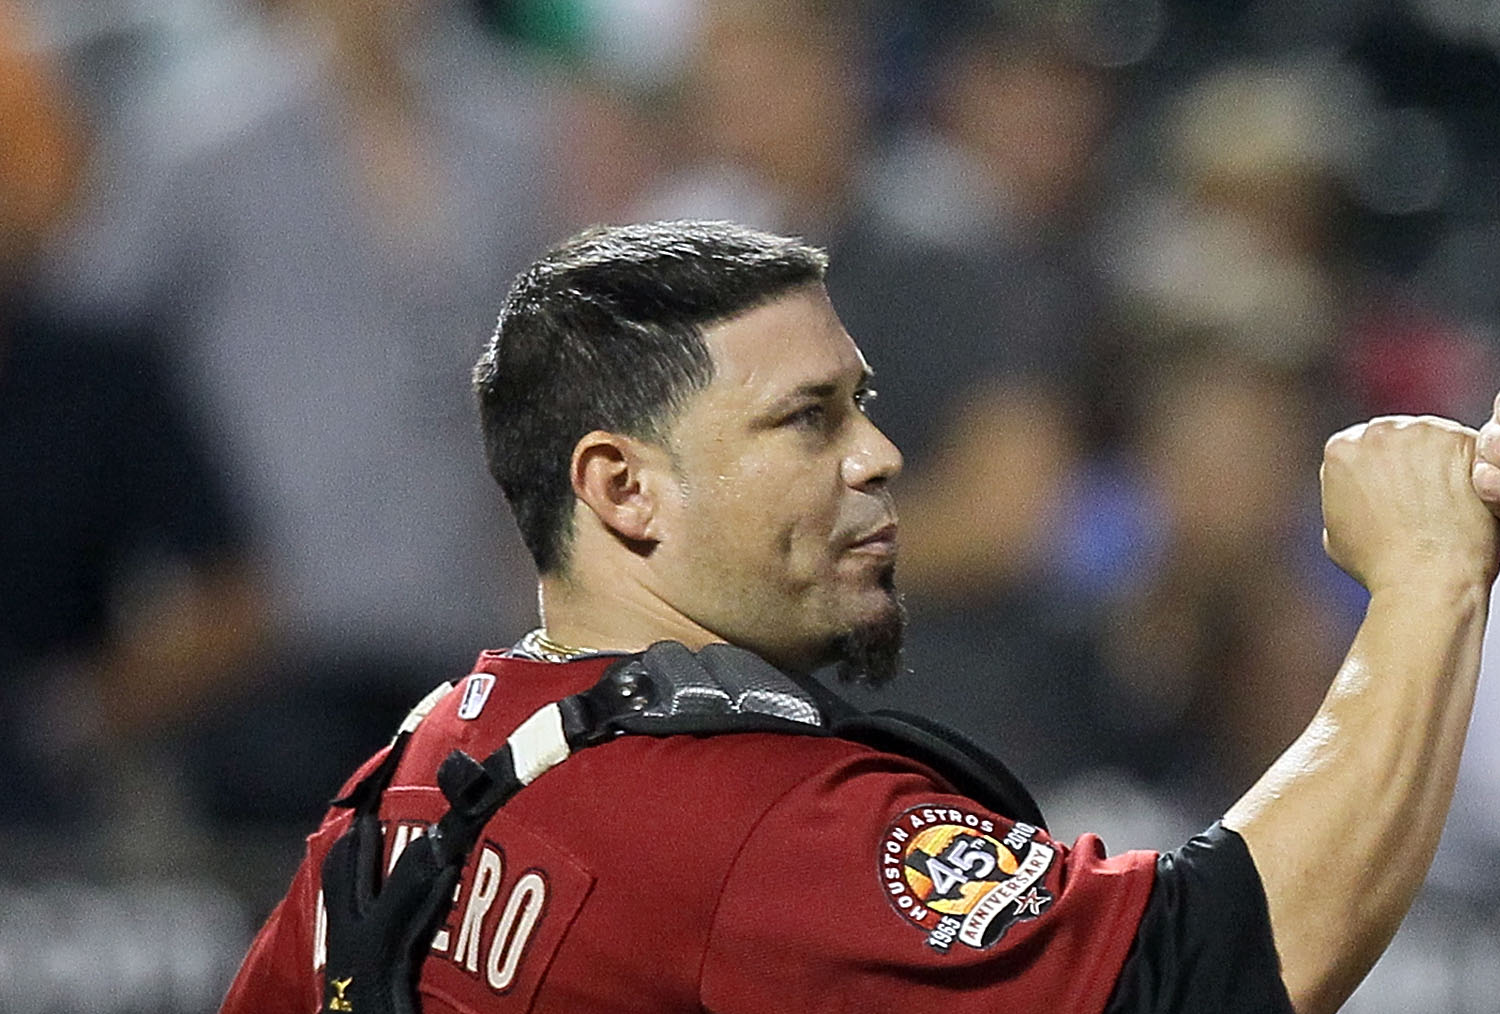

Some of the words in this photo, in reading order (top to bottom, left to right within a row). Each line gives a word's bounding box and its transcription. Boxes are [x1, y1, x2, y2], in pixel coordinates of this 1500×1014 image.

[884, 828, 928, 921] HOUSTON
[910, 808, 994, 833] ASTROS
[1003, 822, 1036, 851] 2010
[963, 849, 1048, 940] ANNIVERSARY
[929, 916, 961, 949] 1965
